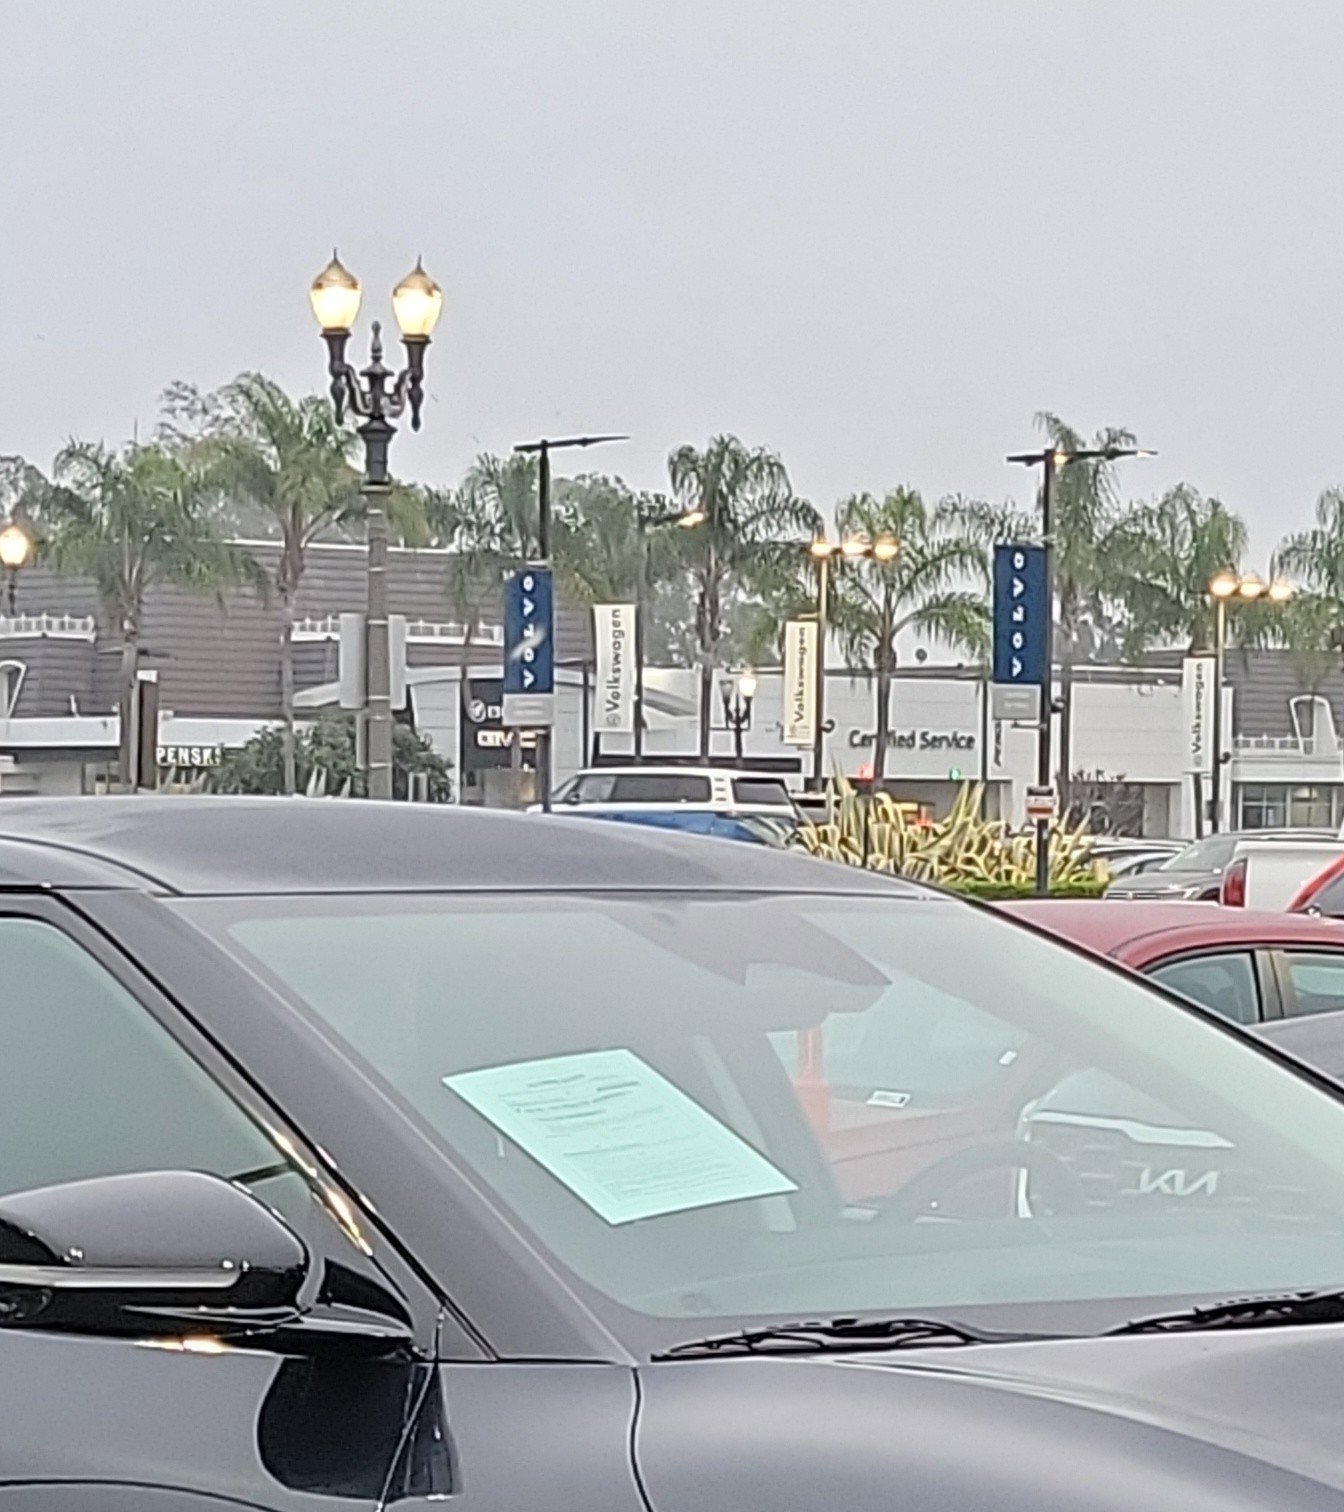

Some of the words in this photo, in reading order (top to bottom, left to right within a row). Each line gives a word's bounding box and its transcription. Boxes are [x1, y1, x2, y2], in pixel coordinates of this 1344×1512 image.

[523, 575, 535, 689] VOLVO
[606, 608, 626, 713] Volkswagen
[1011, 552, 1026, 678] VOLVO
[793, 627, 807, 723] Volkswagen
[919, 731, 977, 750] Service
